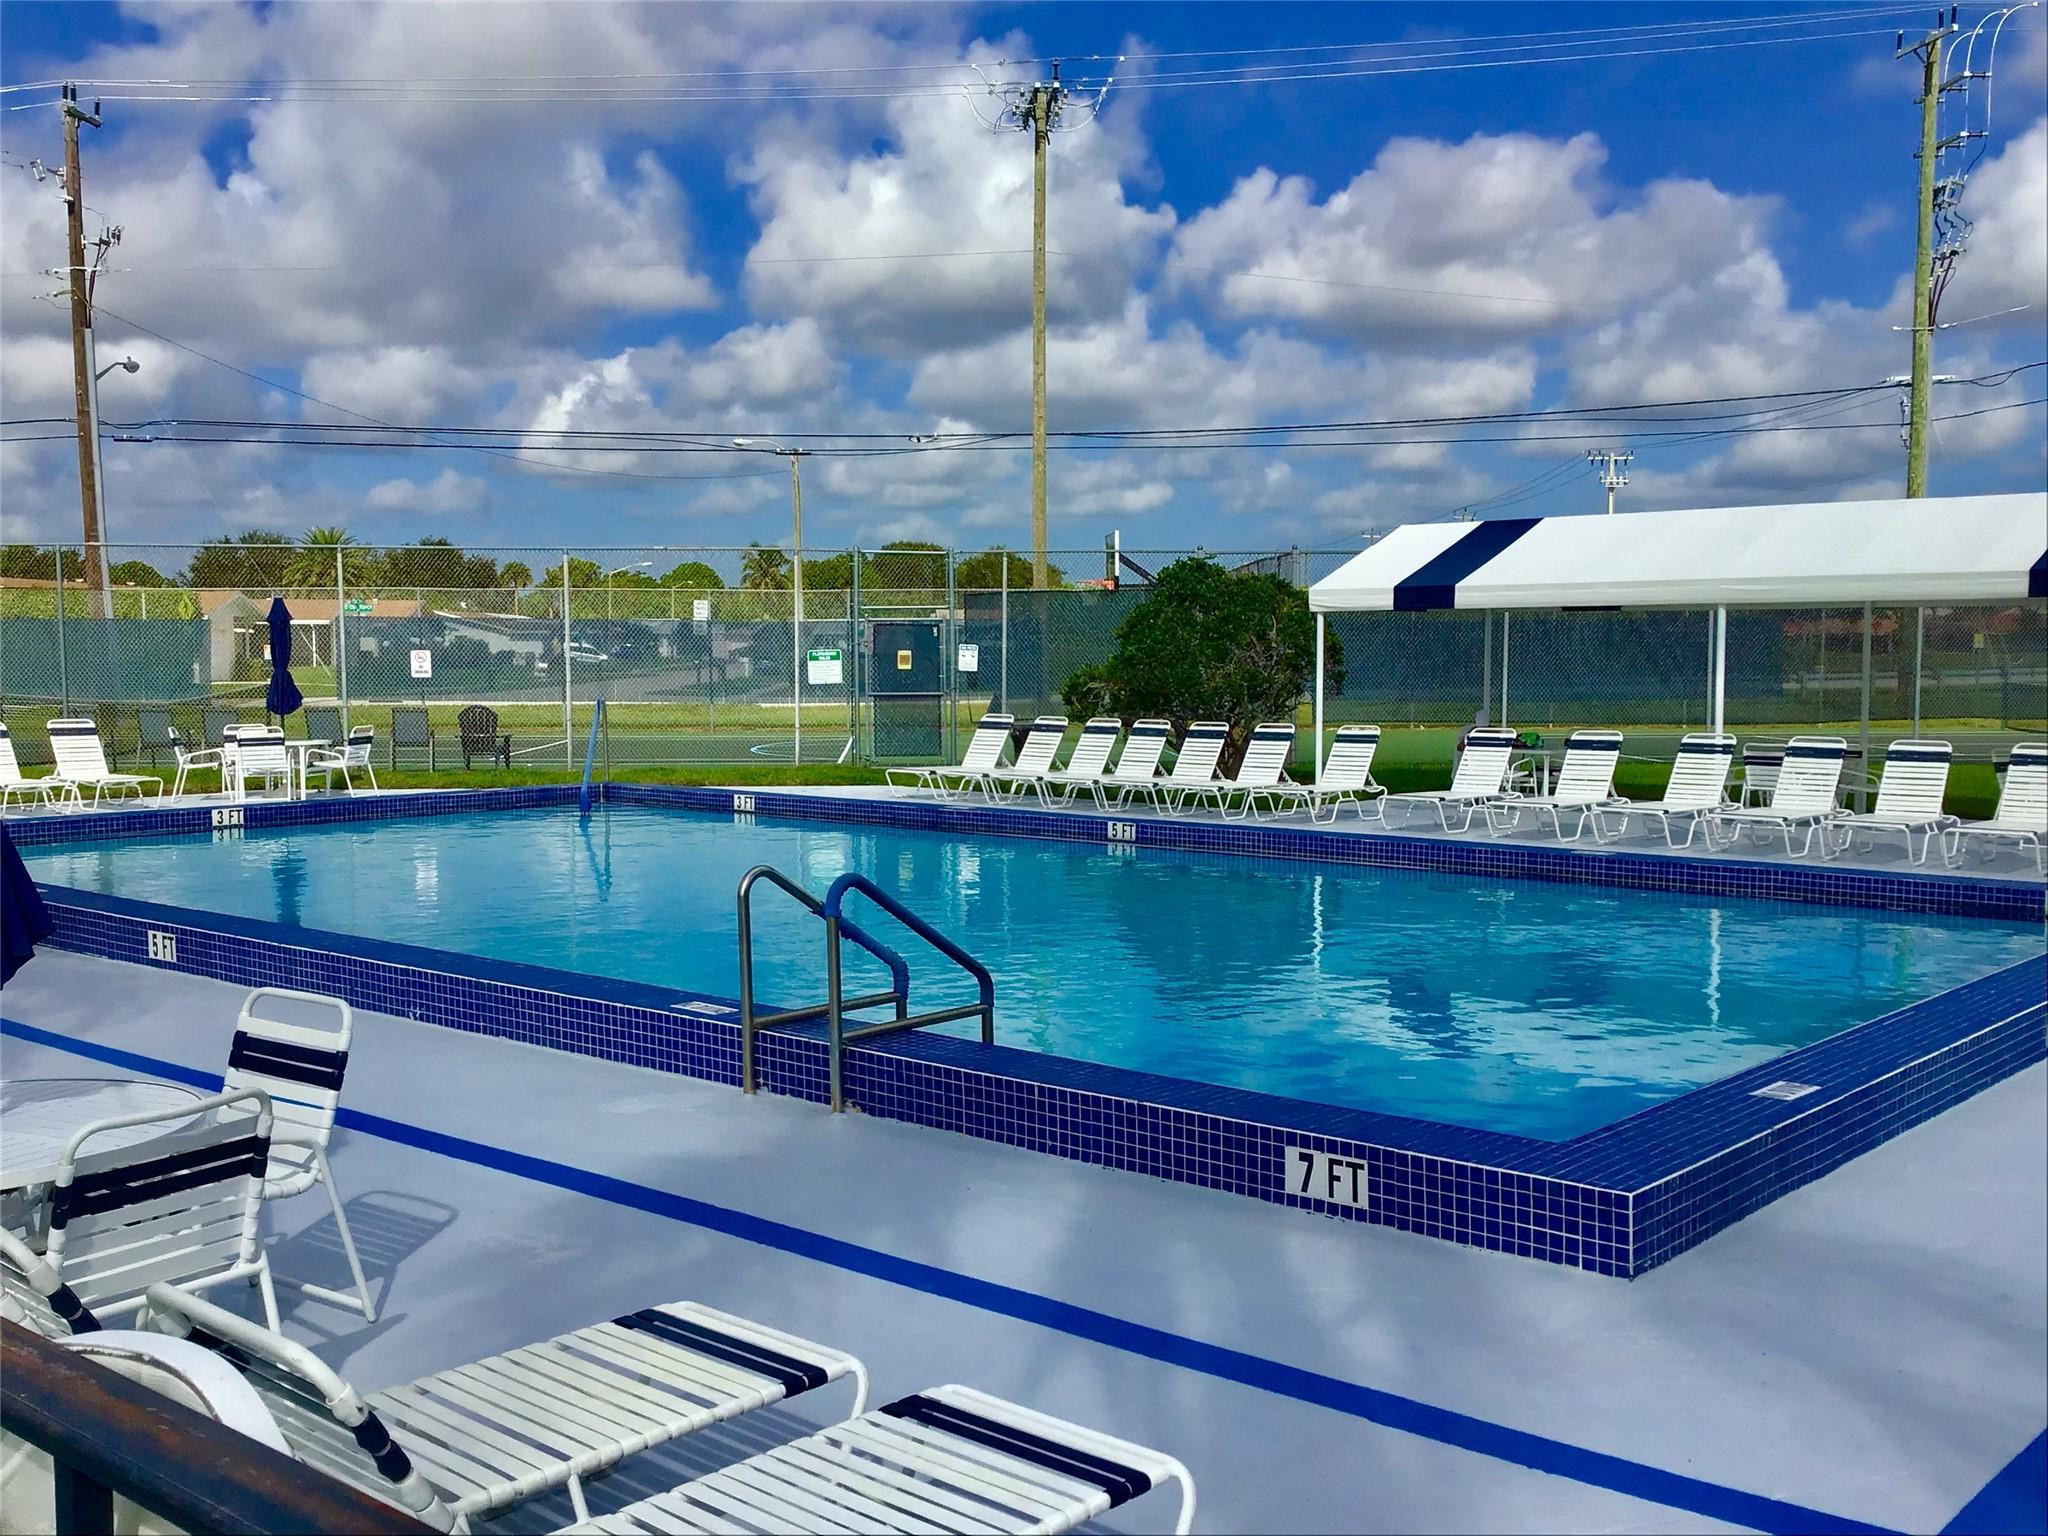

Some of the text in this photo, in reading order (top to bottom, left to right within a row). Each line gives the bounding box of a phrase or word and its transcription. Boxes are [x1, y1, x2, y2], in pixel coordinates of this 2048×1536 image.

[737, 796, 753, 810] 3 FT
[217, 810, 242, 824] 3 FT
[1112, 822, 1134, 840] 5 FT
[152, 934, 174, 960] 5 FT
[1298, 1152, 1365, 1204] 7 FT
